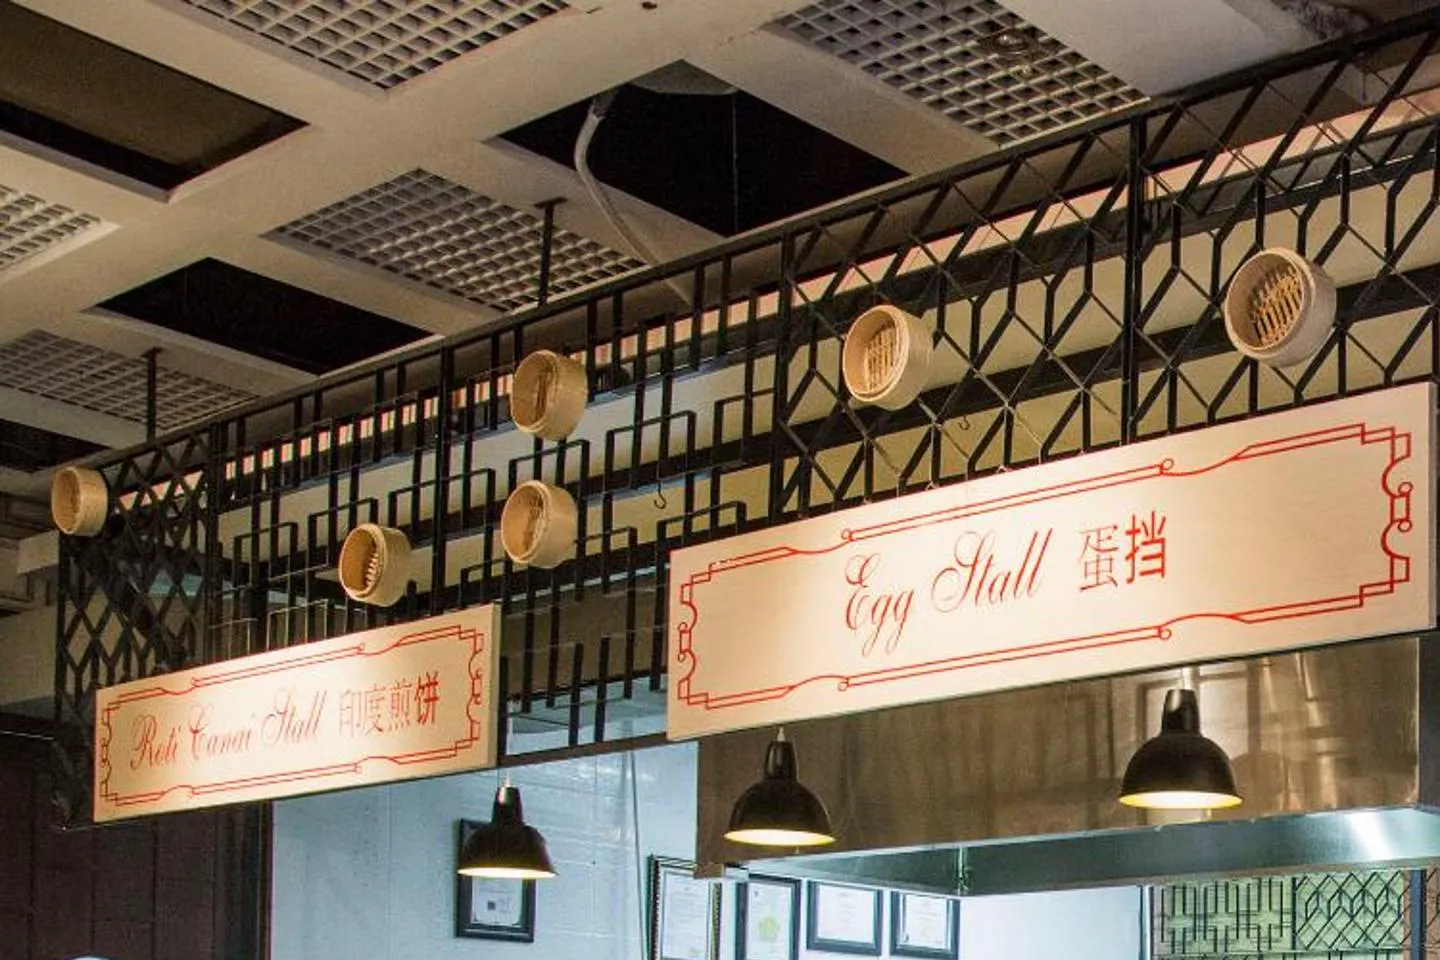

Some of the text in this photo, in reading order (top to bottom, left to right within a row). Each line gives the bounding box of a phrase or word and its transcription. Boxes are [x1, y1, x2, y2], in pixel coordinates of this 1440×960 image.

[844, 527, 1054, 658] Egg Stall
[1077, 510, 1166, 593] 蛋挡
[129, 687, 328, 771] Roti Canai Stall
[338, 670, 440, 738] 印度煎饼
